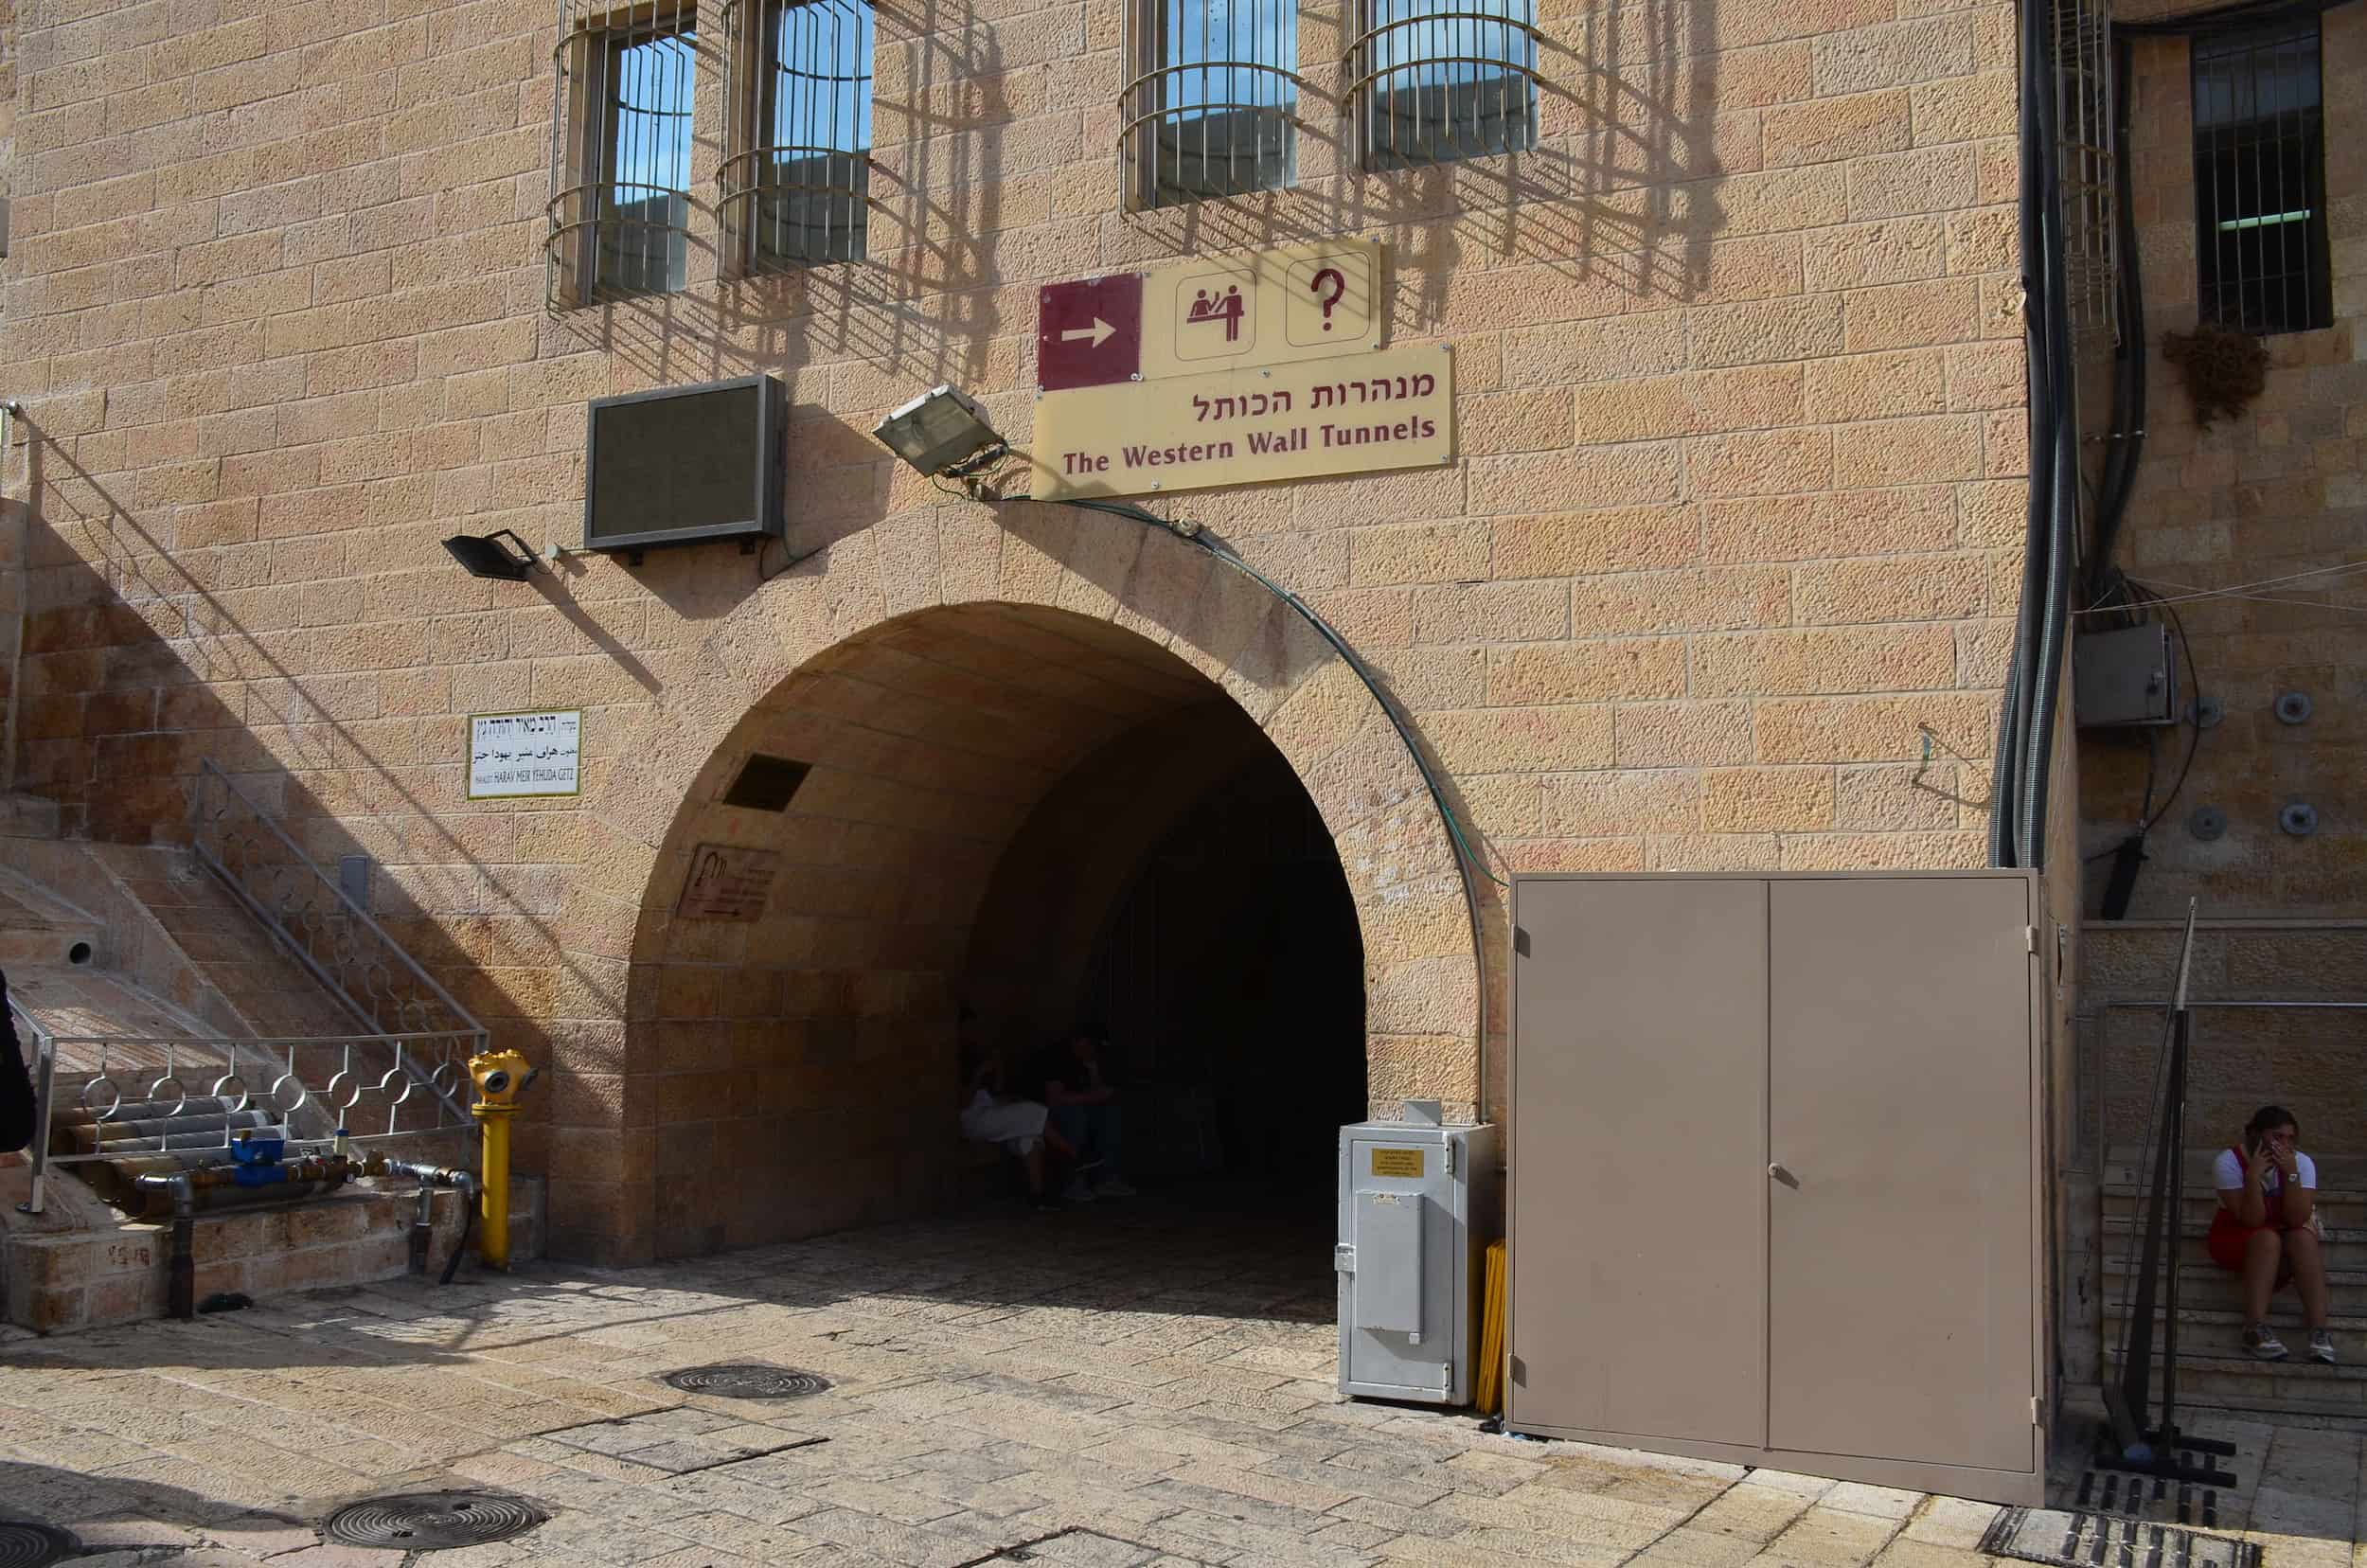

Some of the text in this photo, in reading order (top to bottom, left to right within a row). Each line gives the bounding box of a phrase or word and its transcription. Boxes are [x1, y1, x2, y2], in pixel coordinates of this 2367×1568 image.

[1193, 373, 1435, 422] מנהרות הכותל
[1063, 416, 1435, 474] The Western Wall Tunnels
